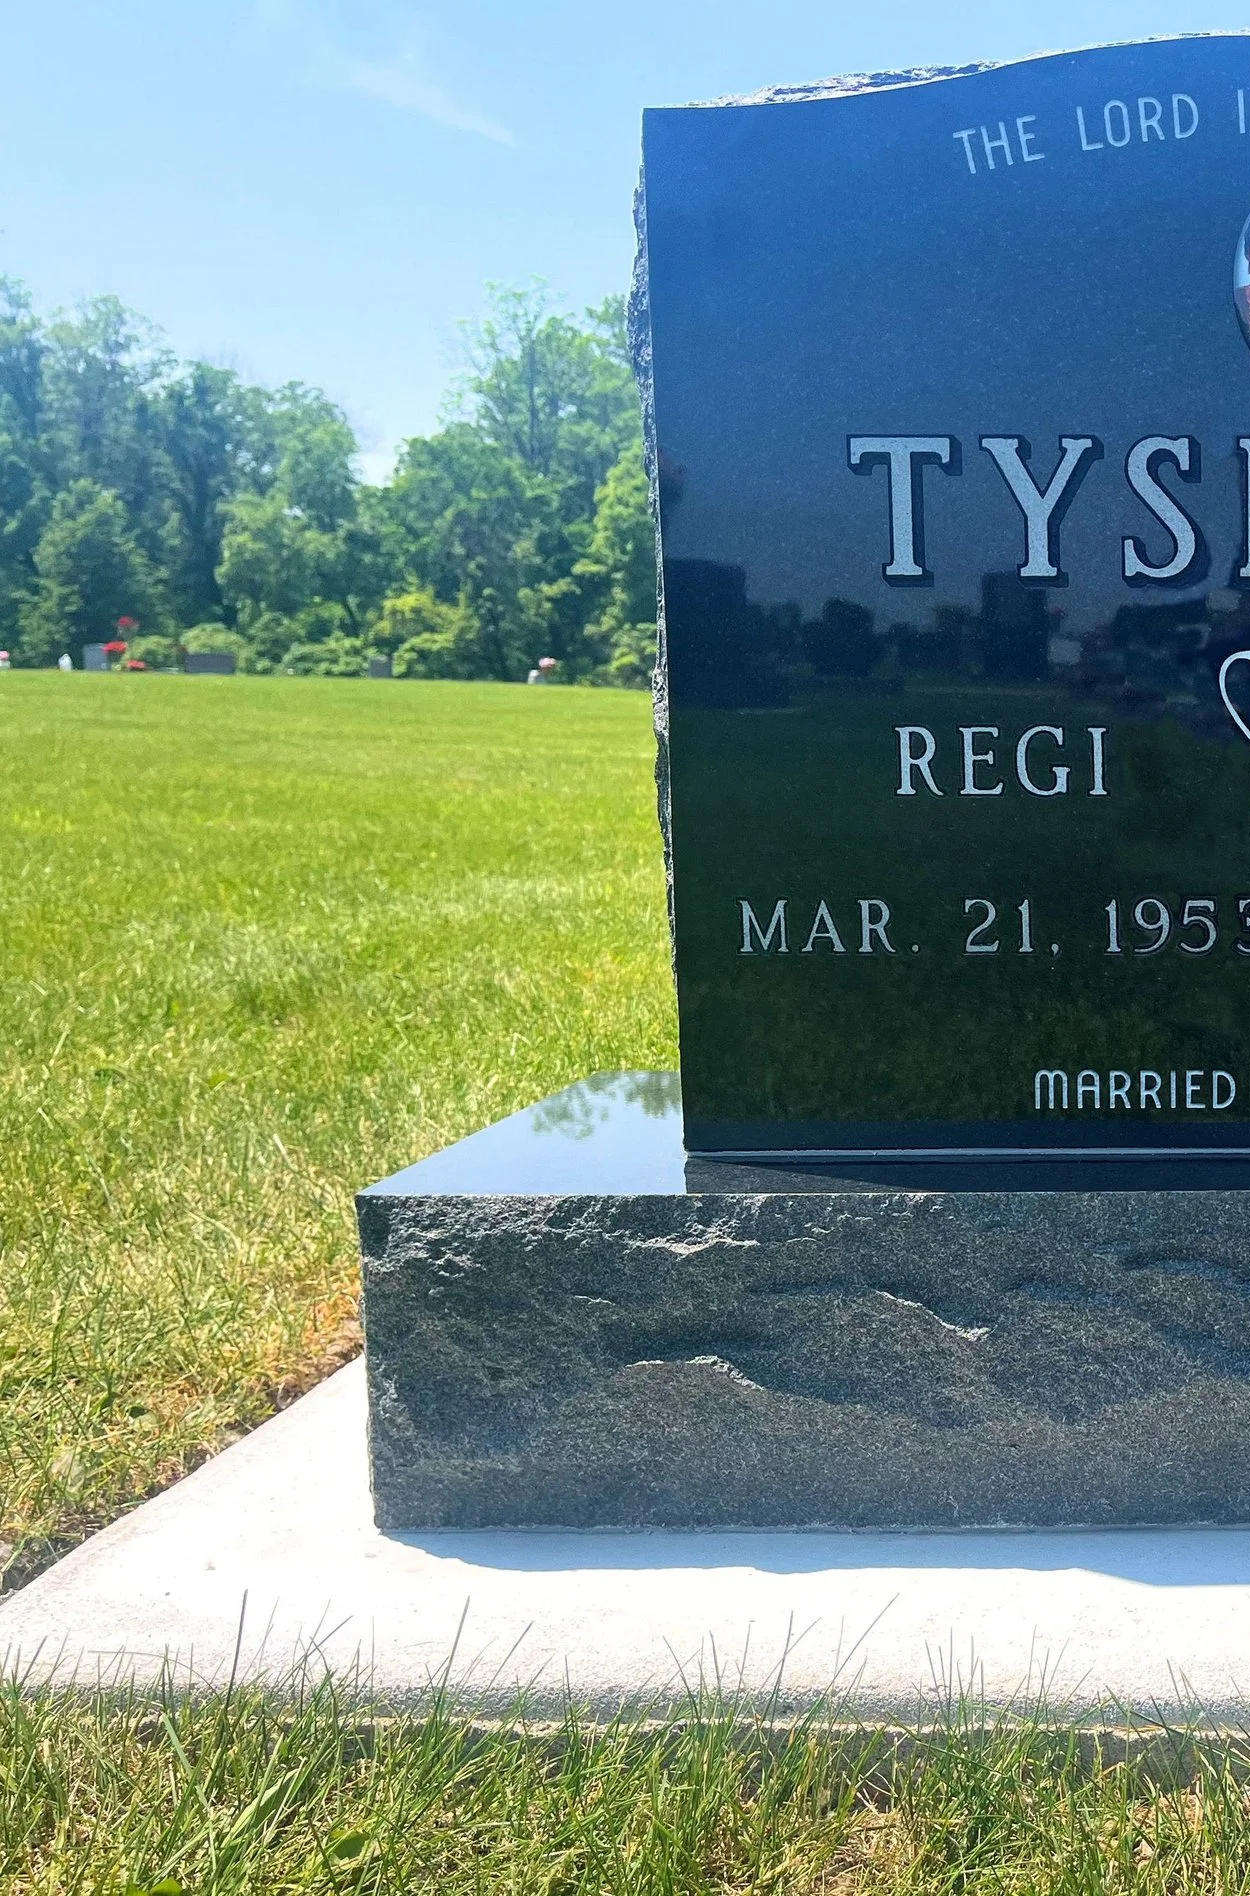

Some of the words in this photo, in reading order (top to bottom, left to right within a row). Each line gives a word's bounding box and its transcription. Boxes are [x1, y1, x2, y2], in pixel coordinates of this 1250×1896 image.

[952, 114, 1046, 175] THE
[1075, 93, 1200, 151] LORD
[893, 725, 1109, 797] REGI
[738, 898, 922, 954] MAR.
[963, 897, 1062, 958] 21,
[1033, 1069, 1237, 1110] MARRIED
